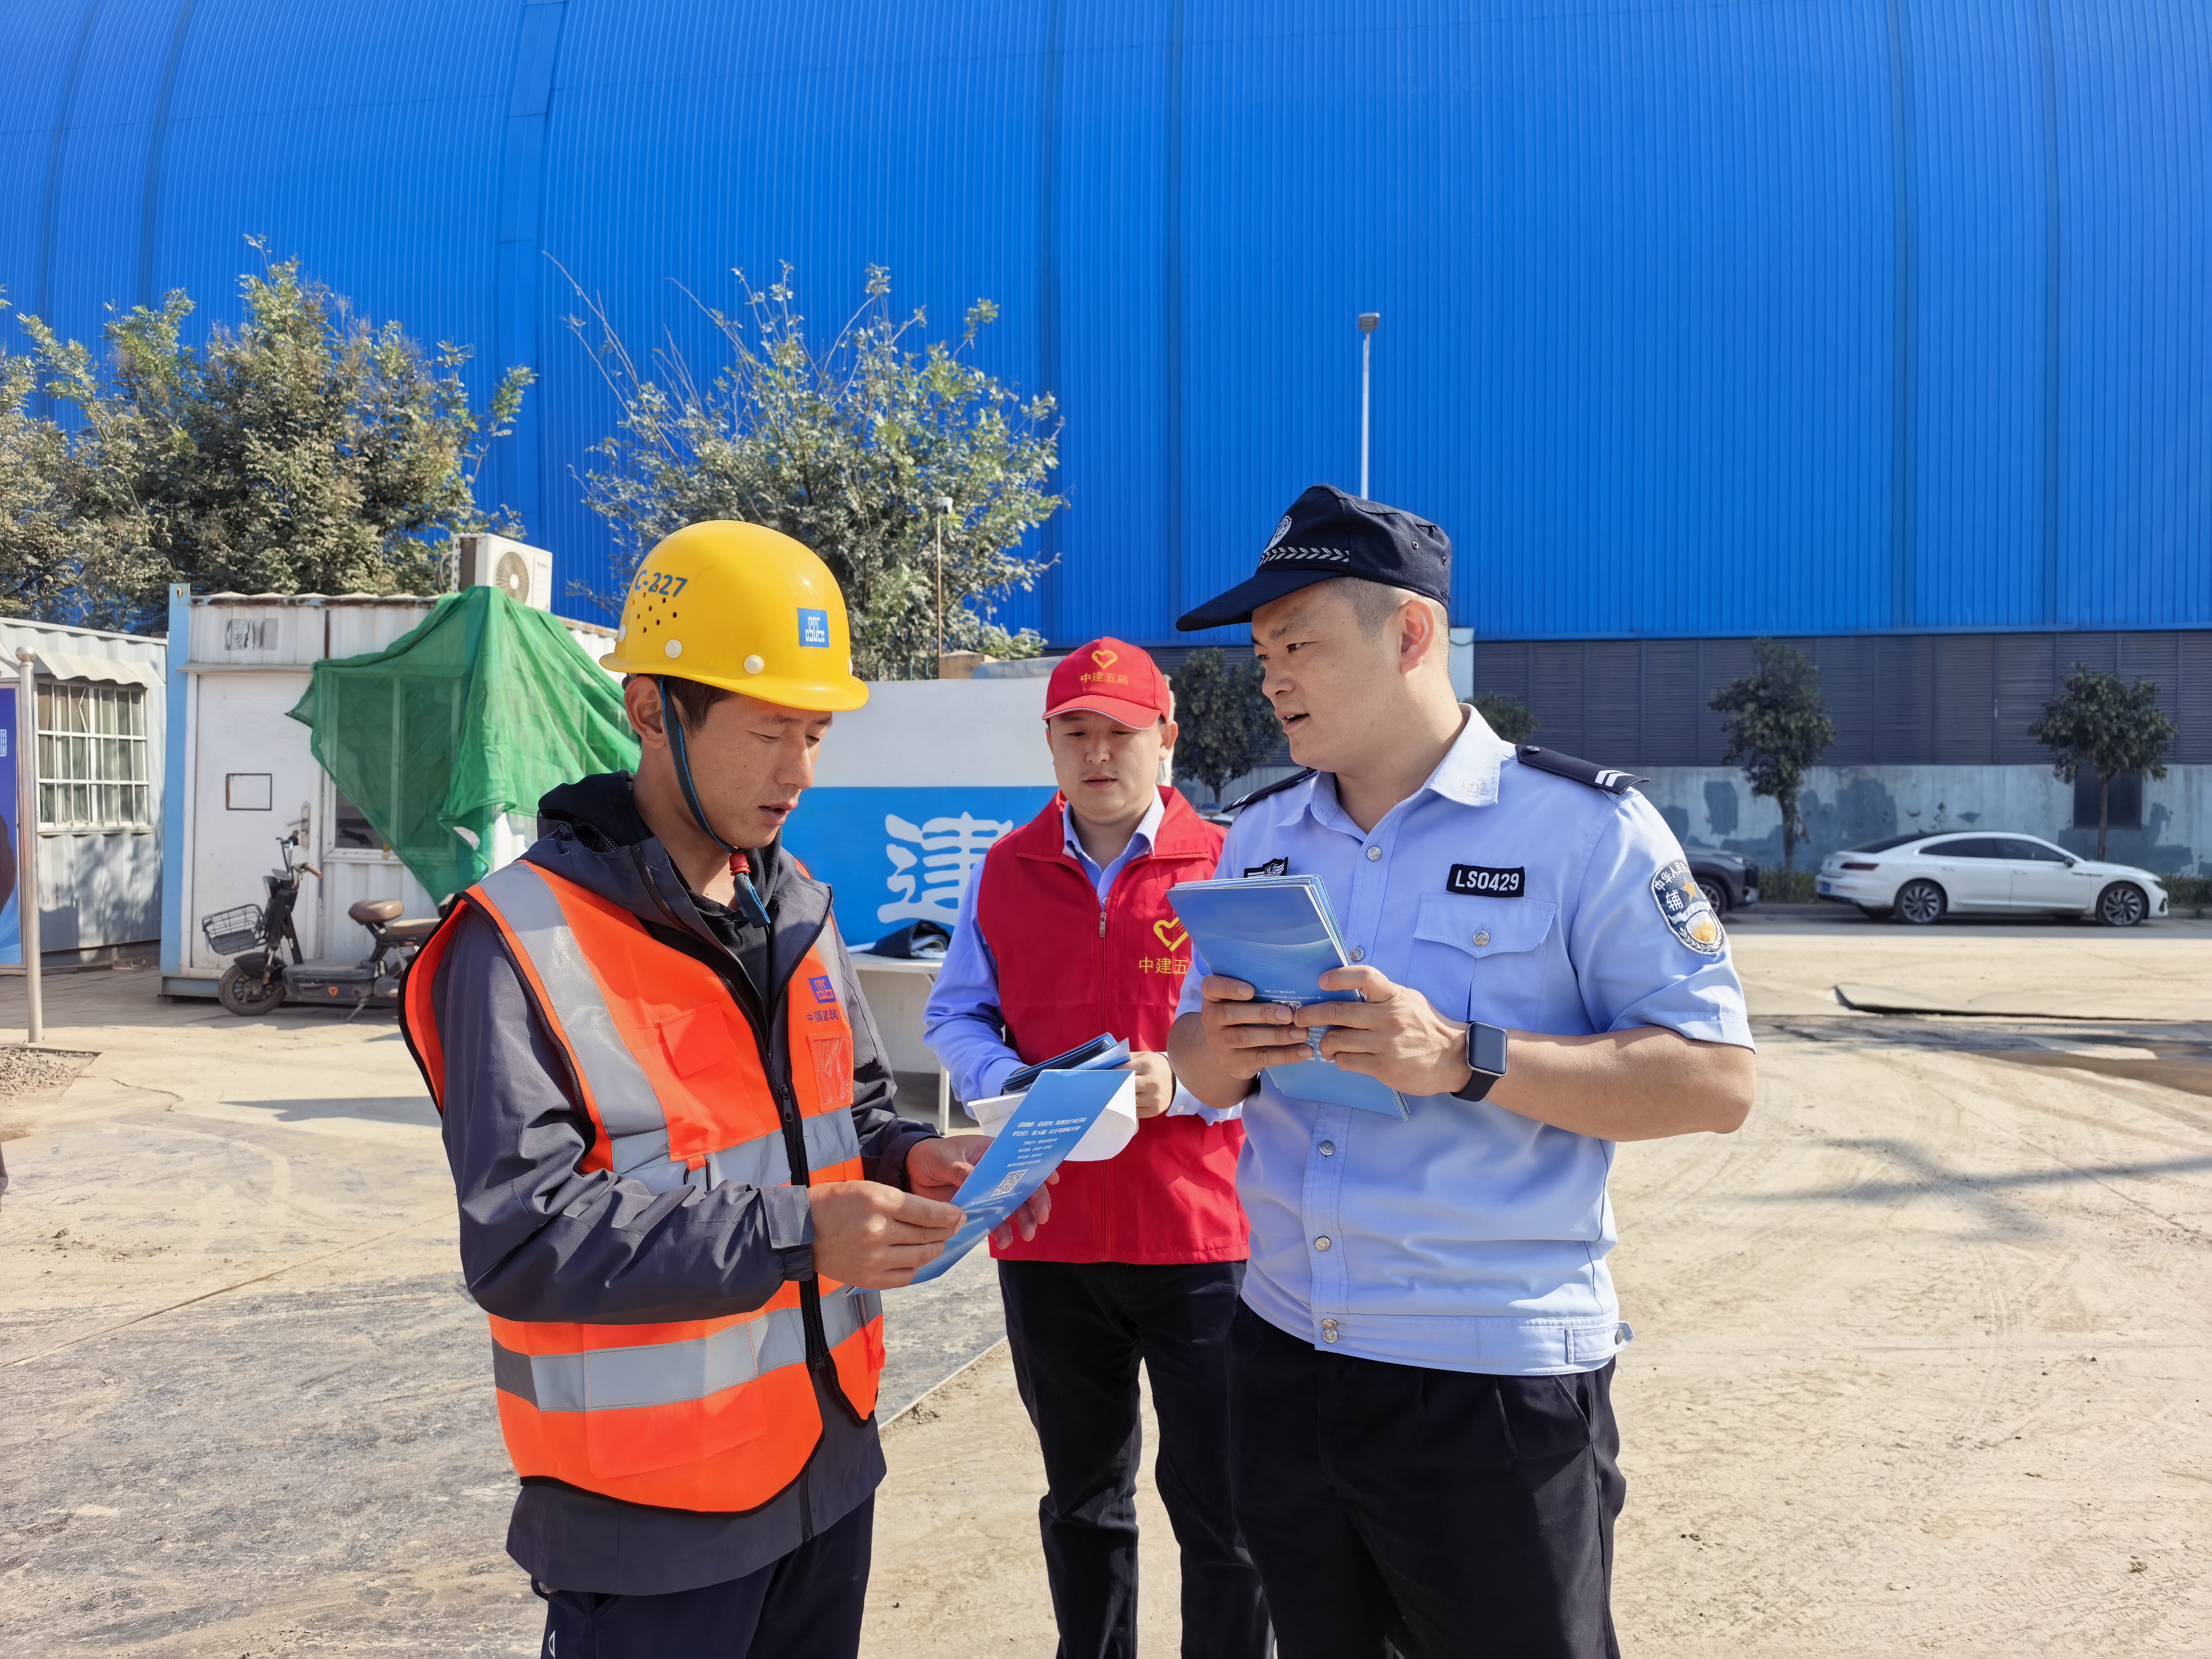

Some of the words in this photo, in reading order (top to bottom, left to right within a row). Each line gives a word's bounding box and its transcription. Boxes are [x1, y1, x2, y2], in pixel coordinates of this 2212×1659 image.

[635, 569, 688, 597] C-227
[1081, 671, 1129, 686] 中建五局
[876, 811, 1014, 927] 建
